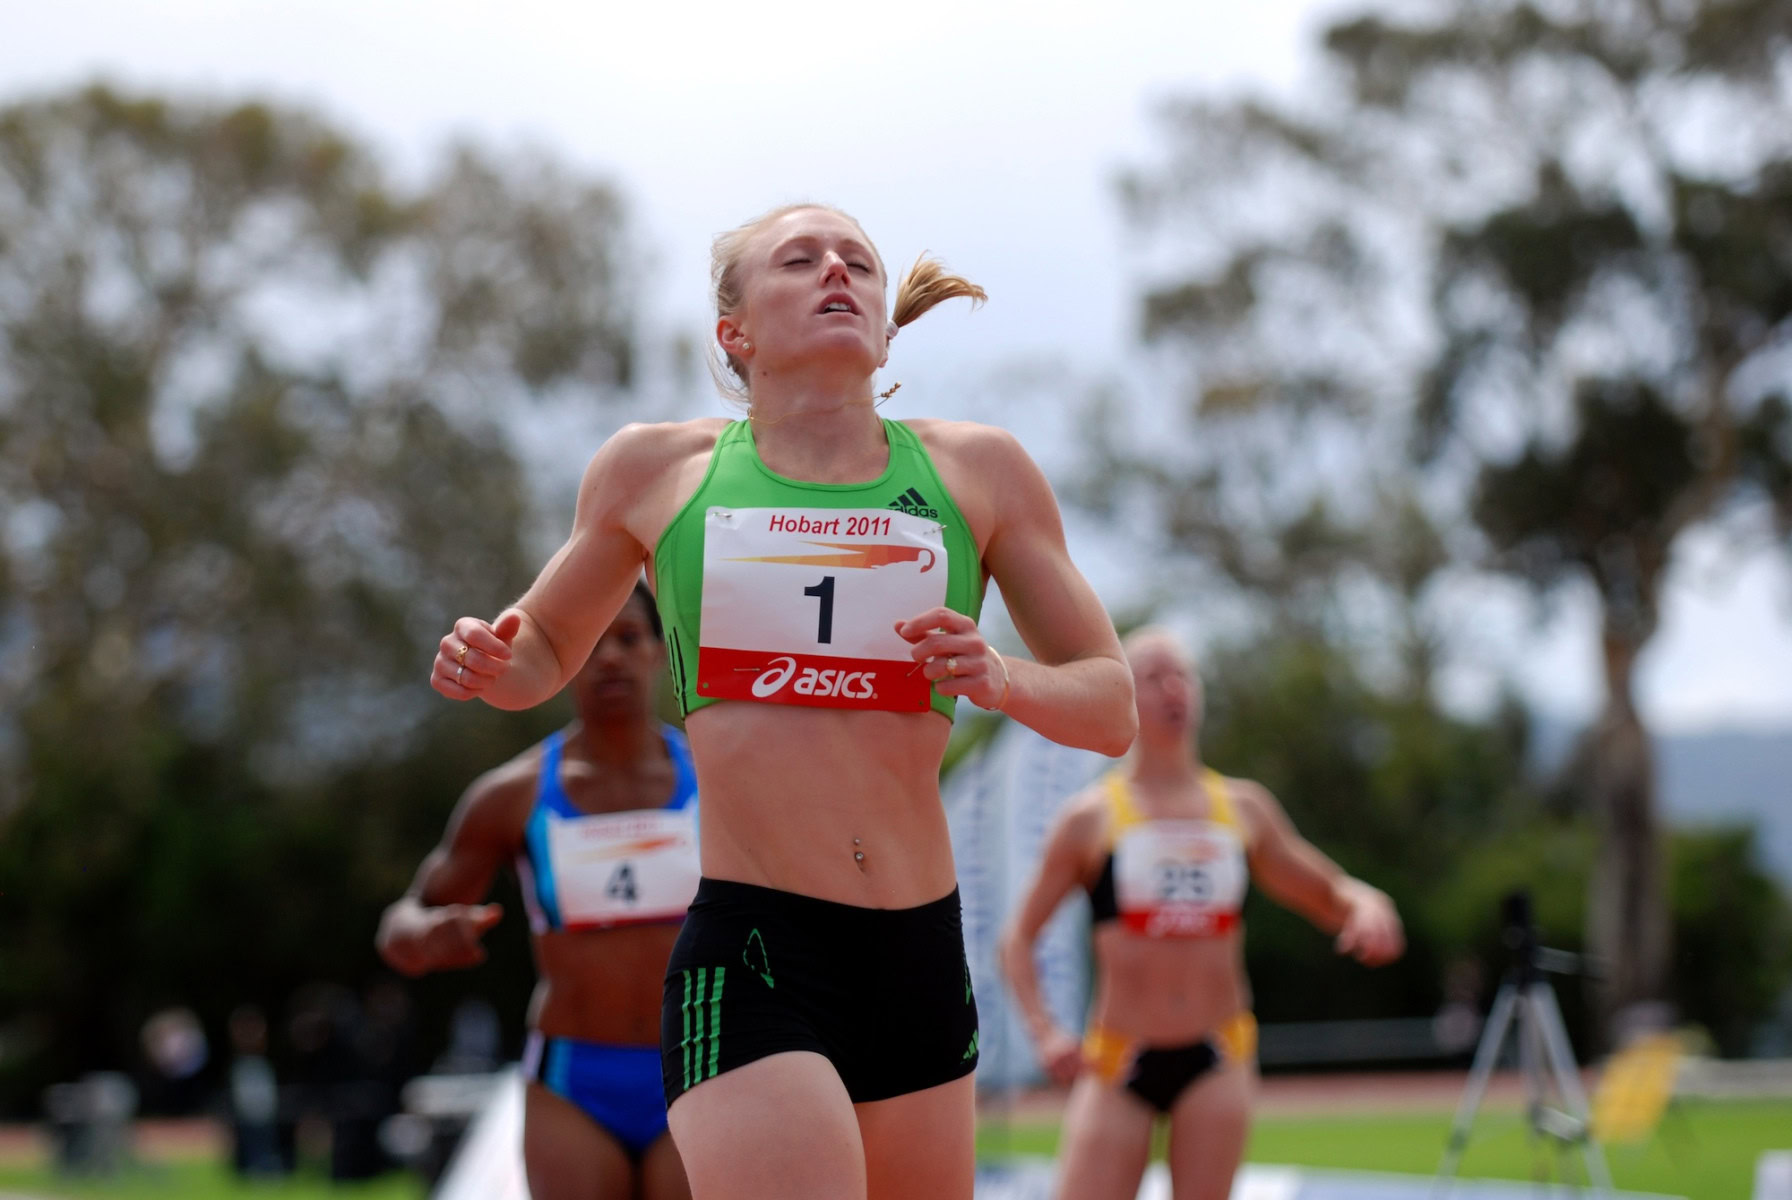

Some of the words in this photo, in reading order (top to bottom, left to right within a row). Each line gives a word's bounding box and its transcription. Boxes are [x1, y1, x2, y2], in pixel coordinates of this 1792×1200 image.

[769, 514, 840, 536] Hobart
[845, 516, 891, 536] 2011
[804, 576, 835, 644] 1
[606, 861, 638, 902] 4
